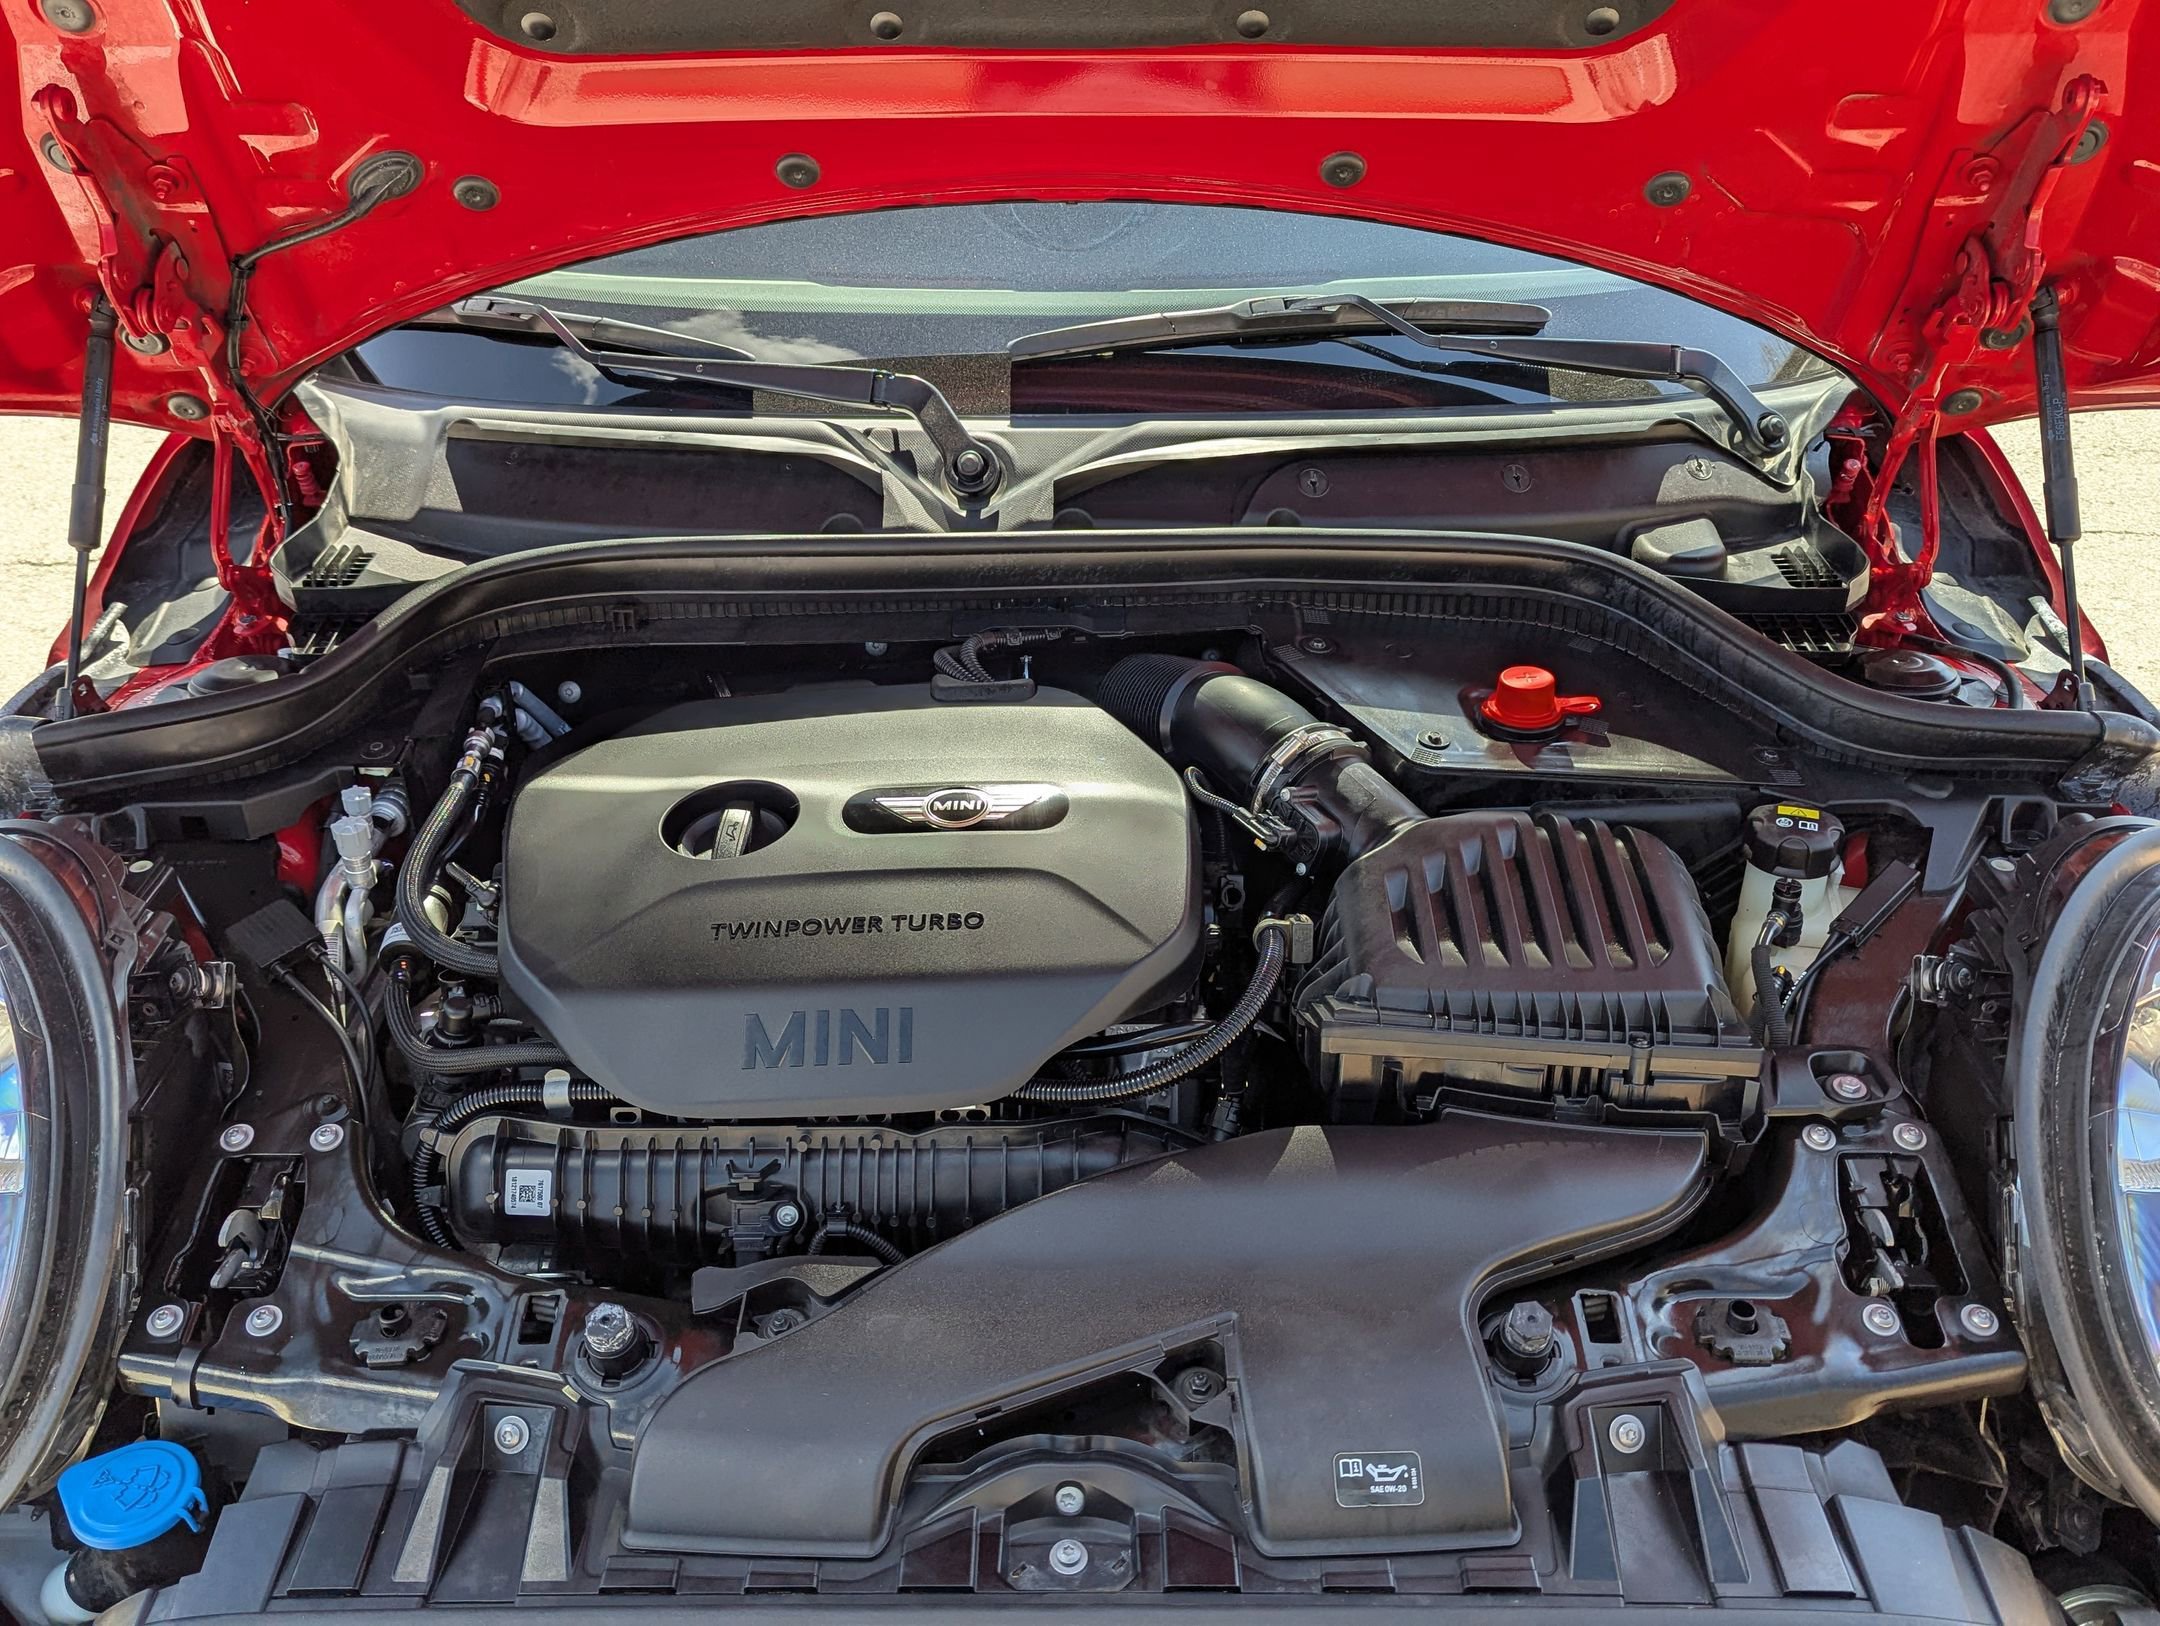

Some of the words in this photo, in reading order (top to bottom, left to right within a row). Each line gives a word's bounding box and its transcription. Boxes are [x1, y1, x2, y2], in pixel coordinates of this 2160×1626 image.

[933, 800, 983, 811] MINI
[710, 914, 883, 941] TWINPOWER
[891, 911, 985, 932] TURBO
[741, 1007, 913, 1070] MINI
[1370, 1485, 1384, 1493] SAE
[1384, 1484, 1408, 1493] 0W-20
